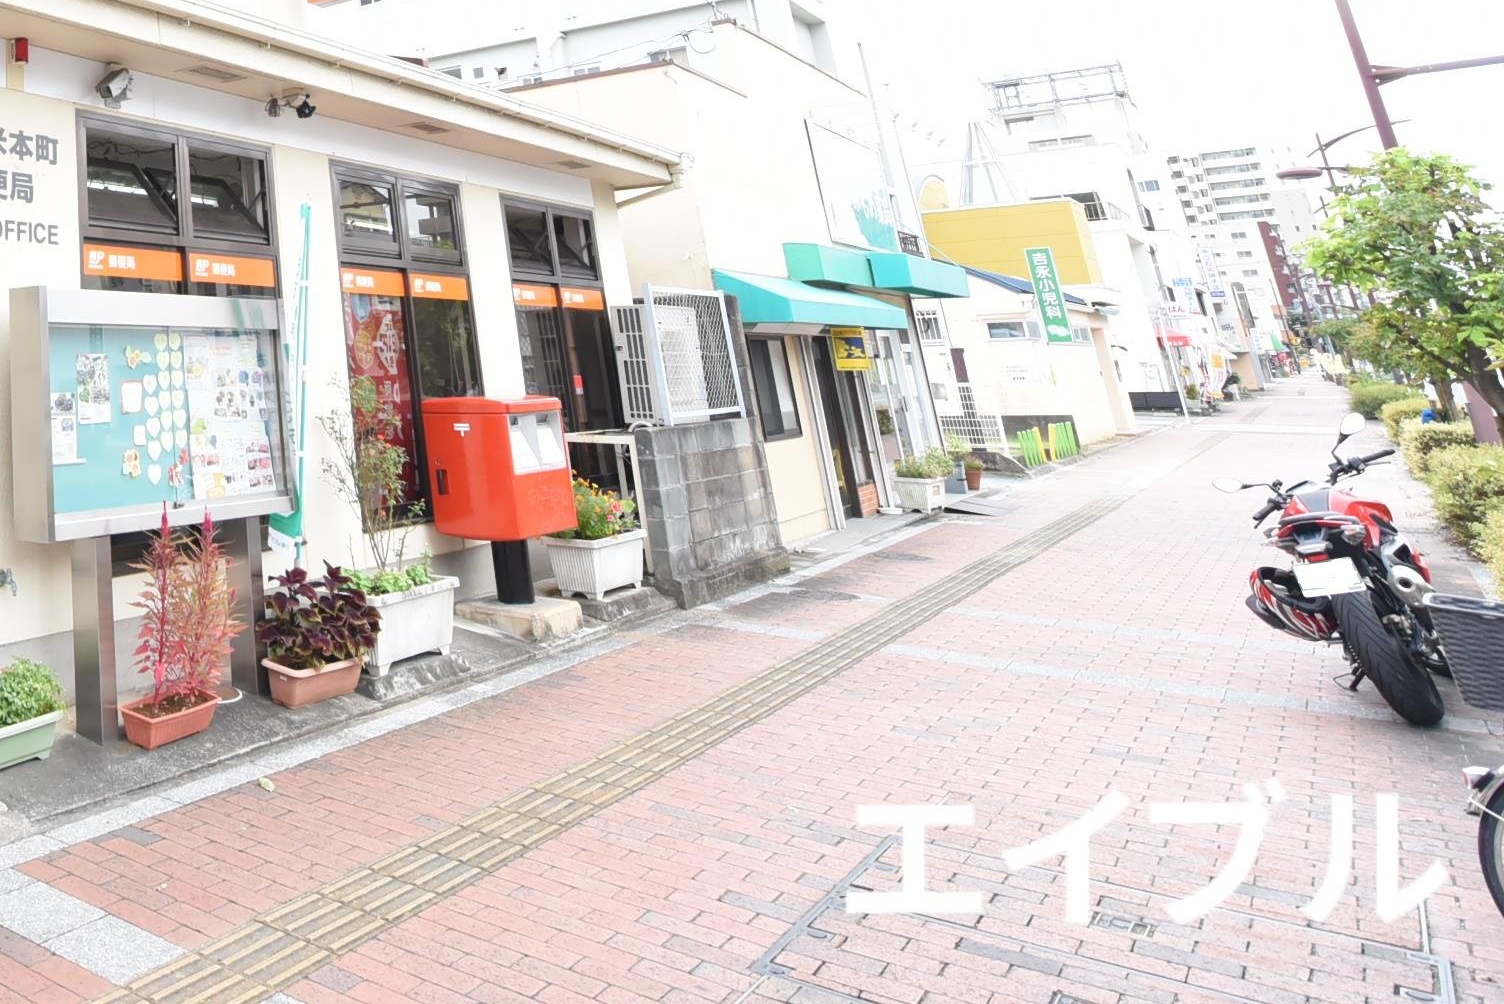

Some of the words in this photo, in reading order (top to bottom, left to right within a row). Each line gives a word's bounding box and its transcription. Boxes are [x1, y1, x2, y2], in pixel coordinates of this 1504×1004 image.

[1032, 252, 1062, 319] 吉永小児科
